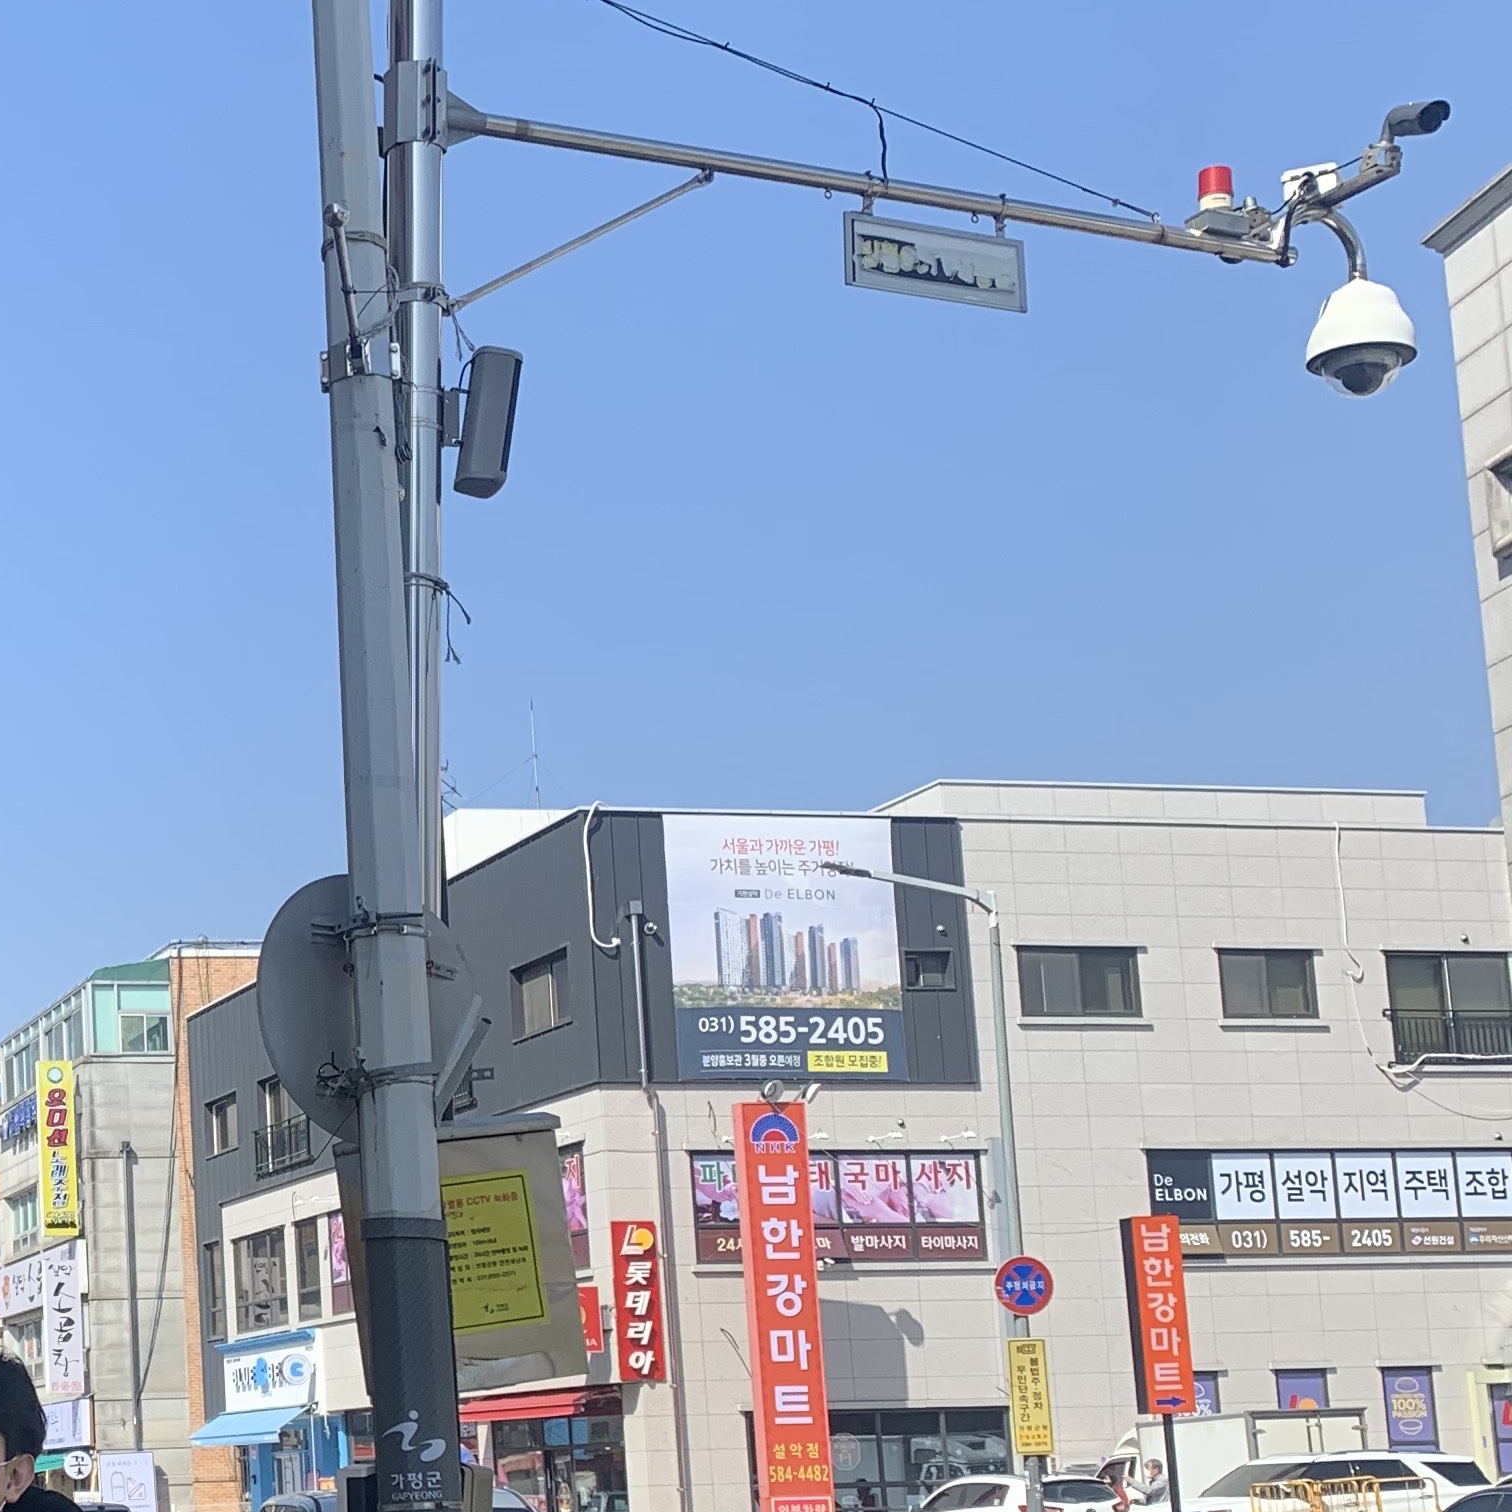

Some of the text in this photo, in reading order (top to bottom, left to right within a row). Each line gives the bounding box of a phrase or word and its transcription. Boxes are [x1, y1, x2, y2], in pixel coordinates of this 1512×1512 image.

[722, 838, 839, 856] 서울과 가까운 가평!
[709, 858, 752, 875] 가치를
[754, 859, 795, 875] 높이는
[764, 889, 782, 900] De
[787, 889, 836, 900] ELBON
[698, 1016, 884, 1044] 031) 585-2405
[814, 1055, 845, 1068] 조합원
[848, 1055, 882, 1068] 모집중!
[50, 1150, 70, 1209] 노래주점
[1154, 1174, 1208, 1202] De ELBON
[1219, 1167, 1509, 1203] 가평 설악 지역 주택 조합
[466, 1194, 491, 1206] CCTV
[851, 1234, 906, 1249] 발마사지
[921, 1235, 978, 1249] 타이마사지
[1231, 1230, 1268, 1249] 031)
[1289, 1229, 1330, 1248] 585-
[1351, 1228, 1393, 1248] 2405
[757, 1164, 814, 1425] 남한강마트
[1006, 1280, 1045, 1291] 주정차금지
[1140, 1223, 1184, 1391] 남한강마트
[624, 1261, 656, 1376] 롯데리아
[52, 1281, 80, 1377] 소곱창
[1391, 1398, 1427, 1411] 100%
[773, 1443, 820, 1459] 설악점
[69, 1455, 88, 1476] 꽃
[769, 1464, 830, 1483] 584-4482
[390, 1471, 442, 1490] 가평군
[391, 1490, 443, 1501] GAPYEONG
